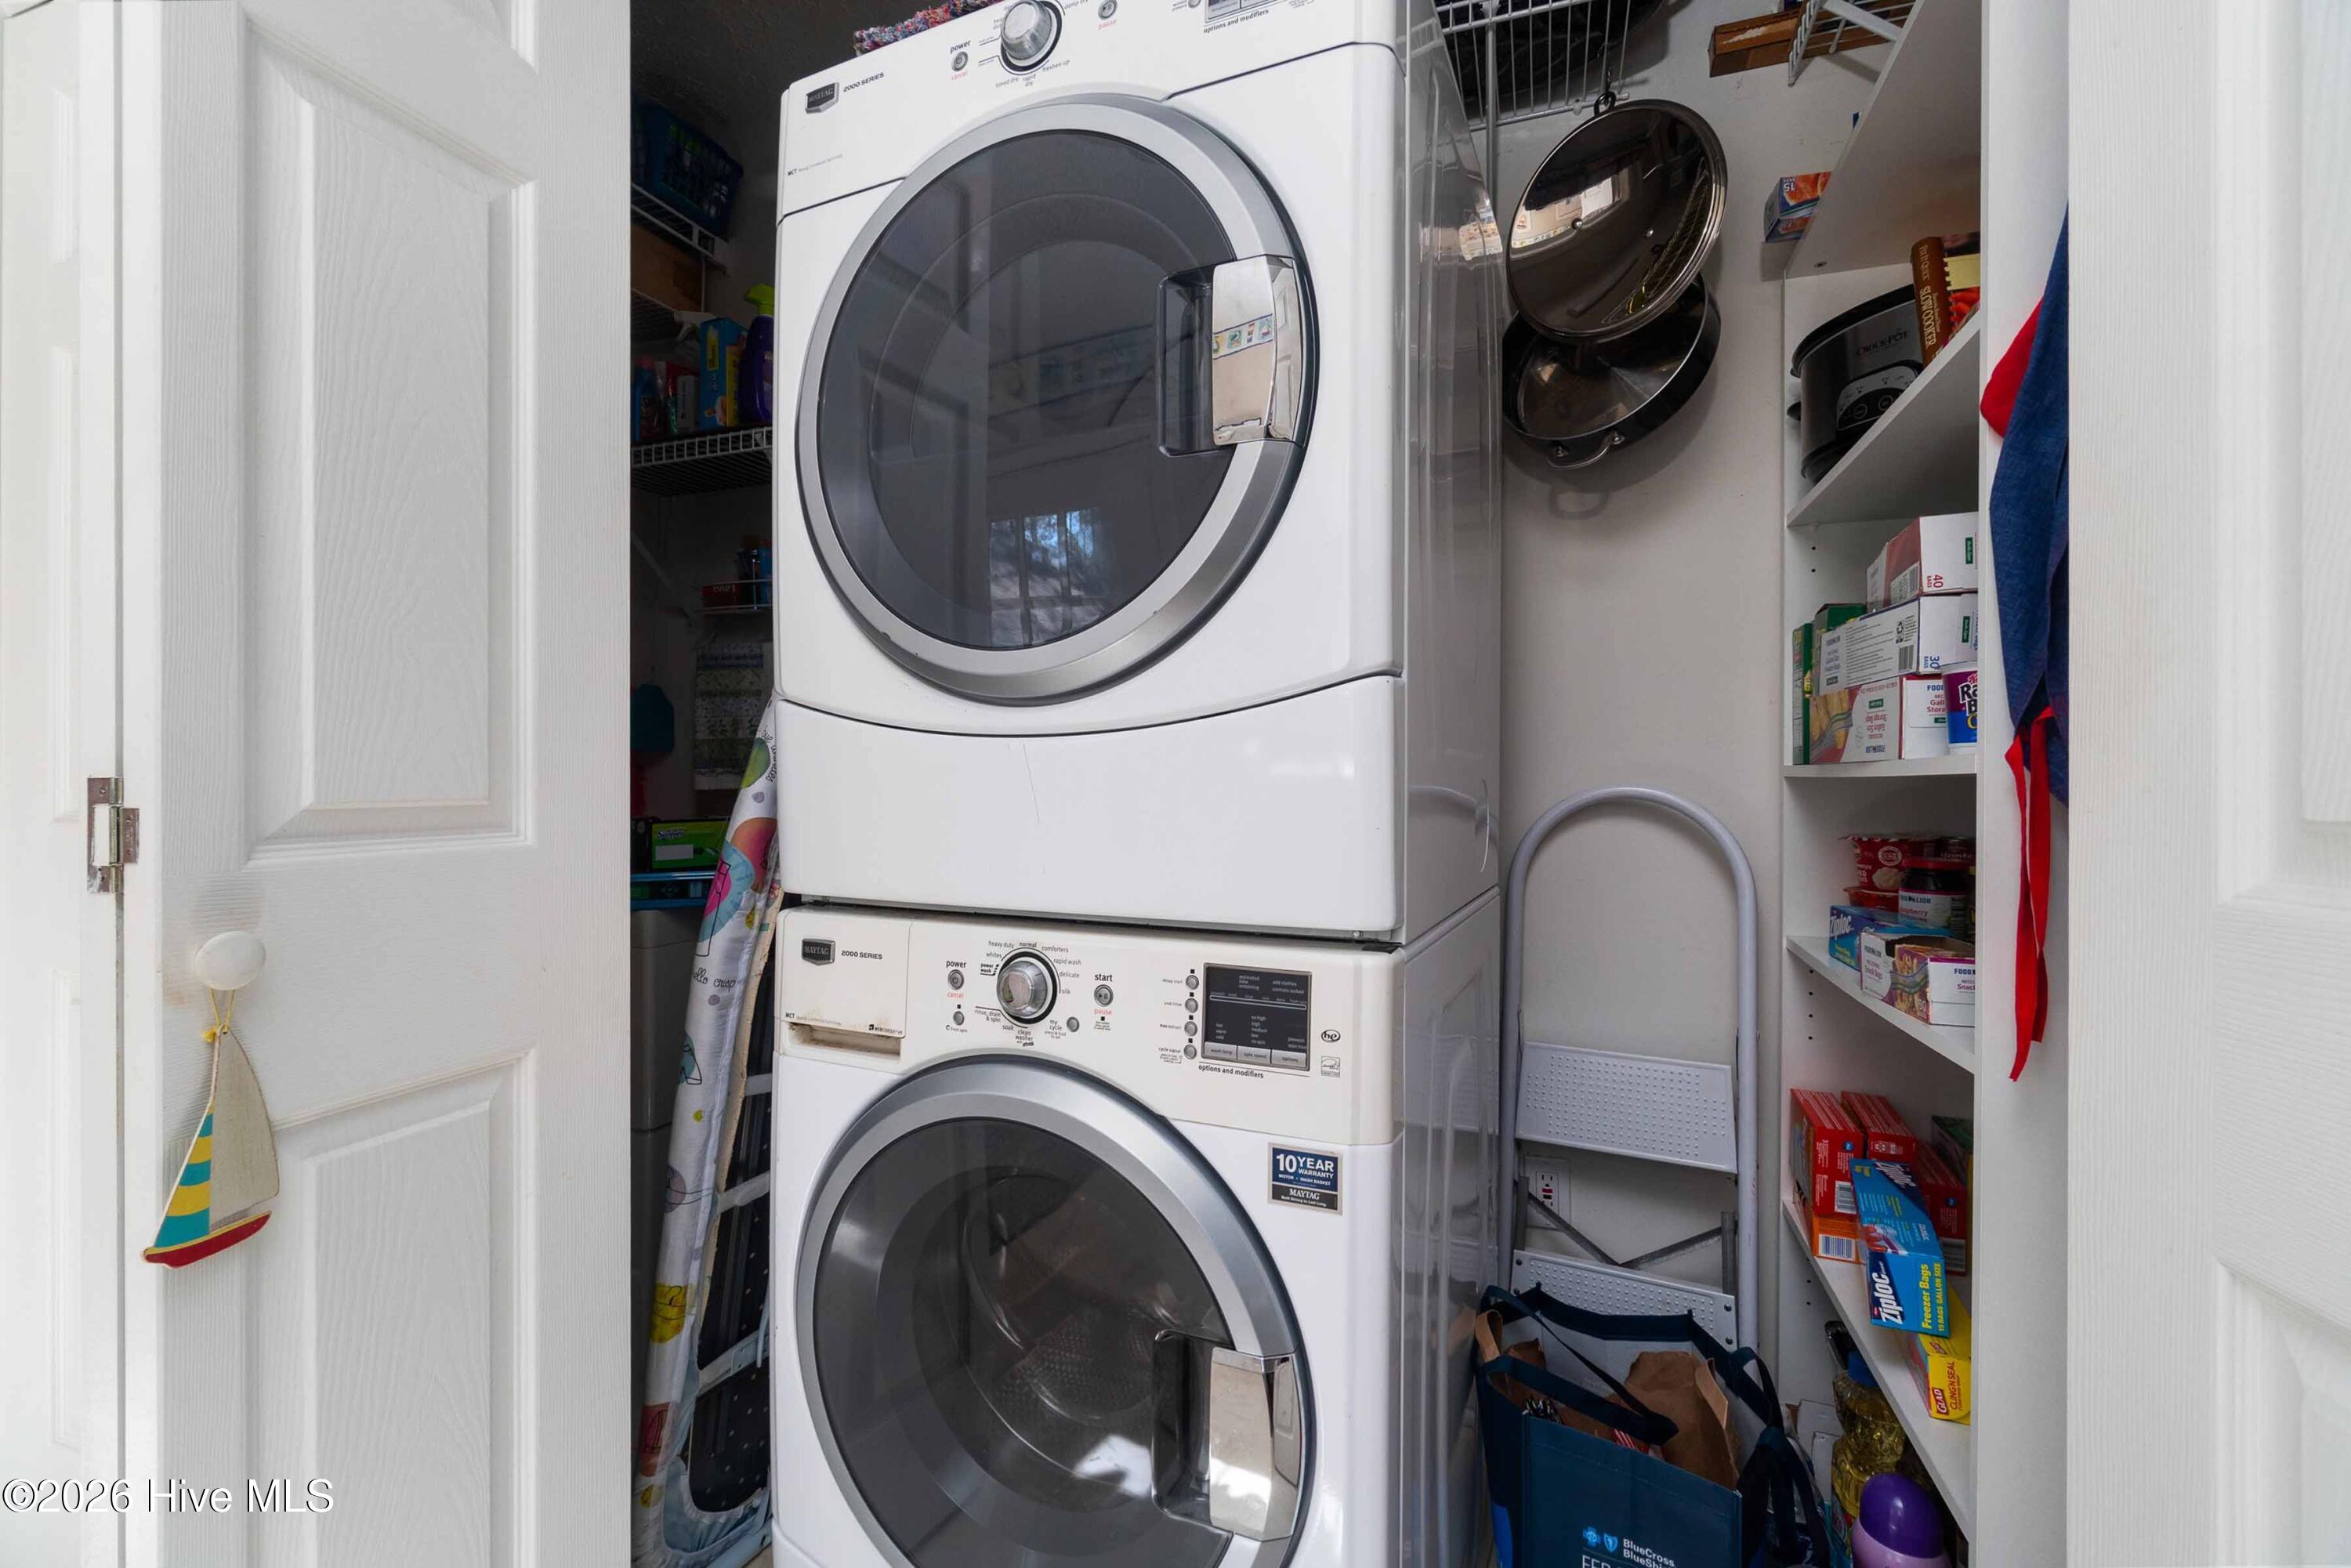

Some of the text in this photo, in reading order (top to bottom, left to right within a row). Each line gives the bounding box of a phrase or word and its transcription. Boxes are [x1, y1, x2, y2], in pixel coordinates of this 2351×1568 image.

[1203, 9, 1270, 34] options and modifiers
[950, 41, 972, 54] power
[1042, 60, 1070, 72] freshen up
[843, 72, 884, 92] 2000 SERIES
[808, 87, 834, 102] MAYTAG
[1783, 183, 1795, 192] 15
[1920, 285, 1933, 311] SLOW
[1922, 310, 1936, 349] COOKER
[1933, 574, 1943, 588] 40
[1929, 656, 1940, 669] 30
[1831, 914, 1852, 940] Ziploc
[804, 945, 829, 955] MAYTAG
[693, 966, 736, 993] ello crisp
[1199, 1064, 1221, 1074] options
[1234, 1069, 1263, 1078] modifiers
[1277, 1153, 1334, 1172] 10 YEAR
[1298, 1168, 1334, 1179] WARRANTY
[1289, 1189, 1320, 1200] MAYTAG
[1872, 1273, 1904, 1324] Ziploc
[1919, 1263, 1933, 1329] Freezer Bags
[1935, 1280, 1943, 1303] GALLON
[1947, 1360, 1956, 1380] SEAL
[1934, 1389, 1947, 1414] GLAD
[1623, 1537, 1675, 1567] BlueCross
[1623, 1548, 1663, 1568] BlueShi
